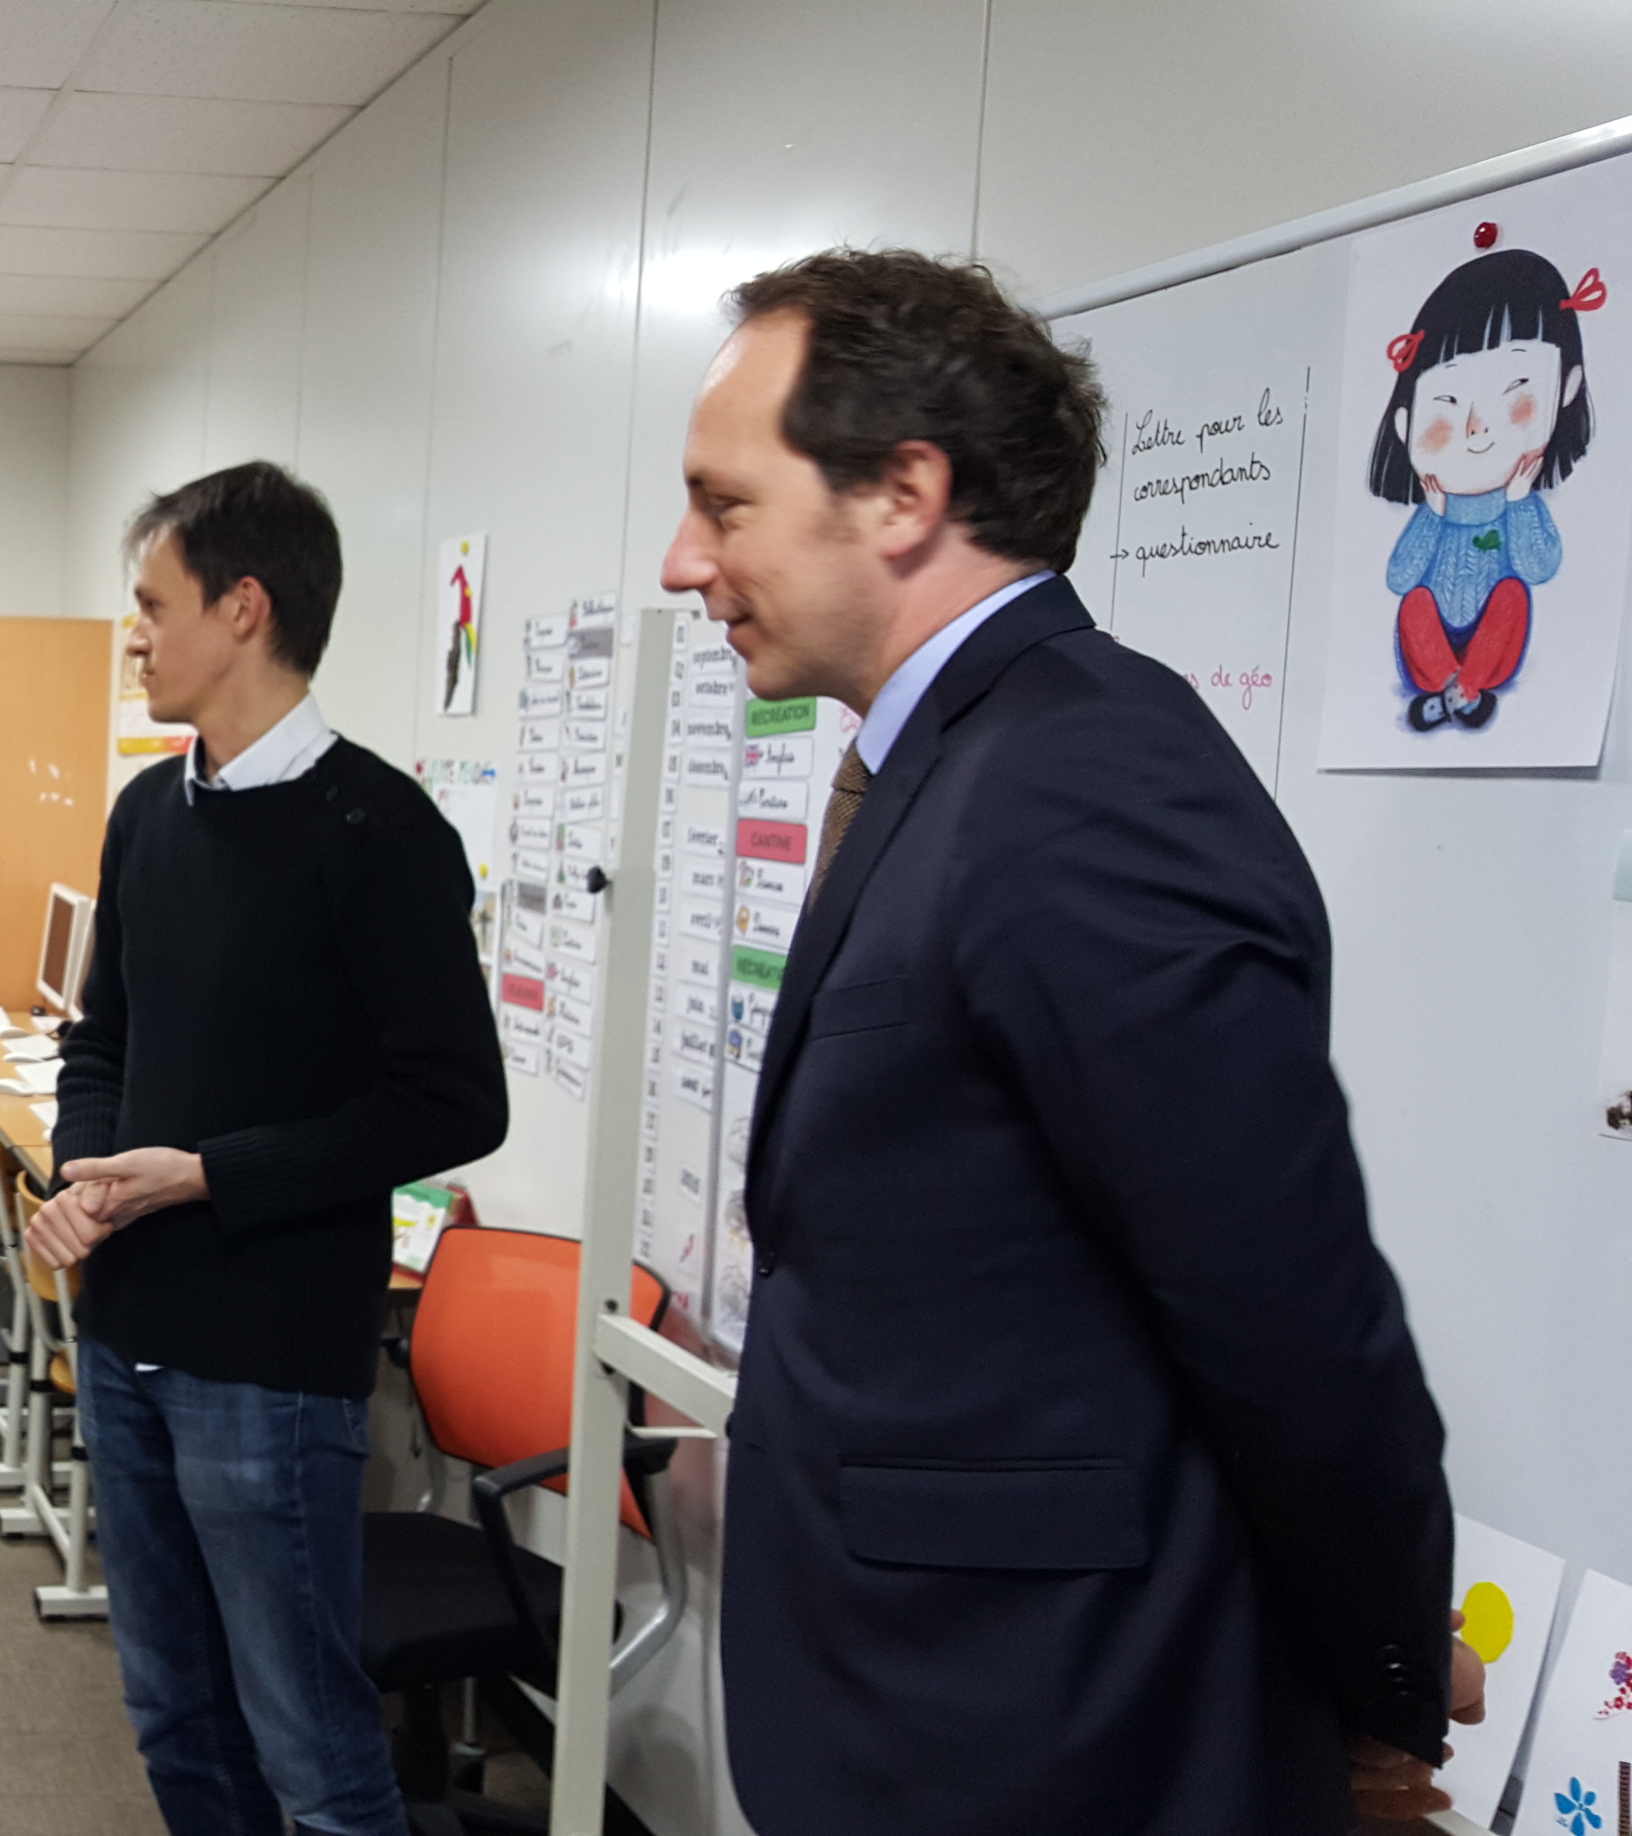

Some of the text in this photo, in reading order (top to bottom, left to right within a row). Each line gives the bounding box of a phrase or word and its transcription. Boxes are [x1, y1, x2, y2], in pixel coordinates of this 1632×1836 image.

[1132, 387, 1283, 455] Lettre pour les
[1133, 451, 1271, 504] correspondants
[1135, 521, 1280, 578] questionnaire
[1211, 664, 1233, 688] de
[1239, 664, 1273, 710] géo
